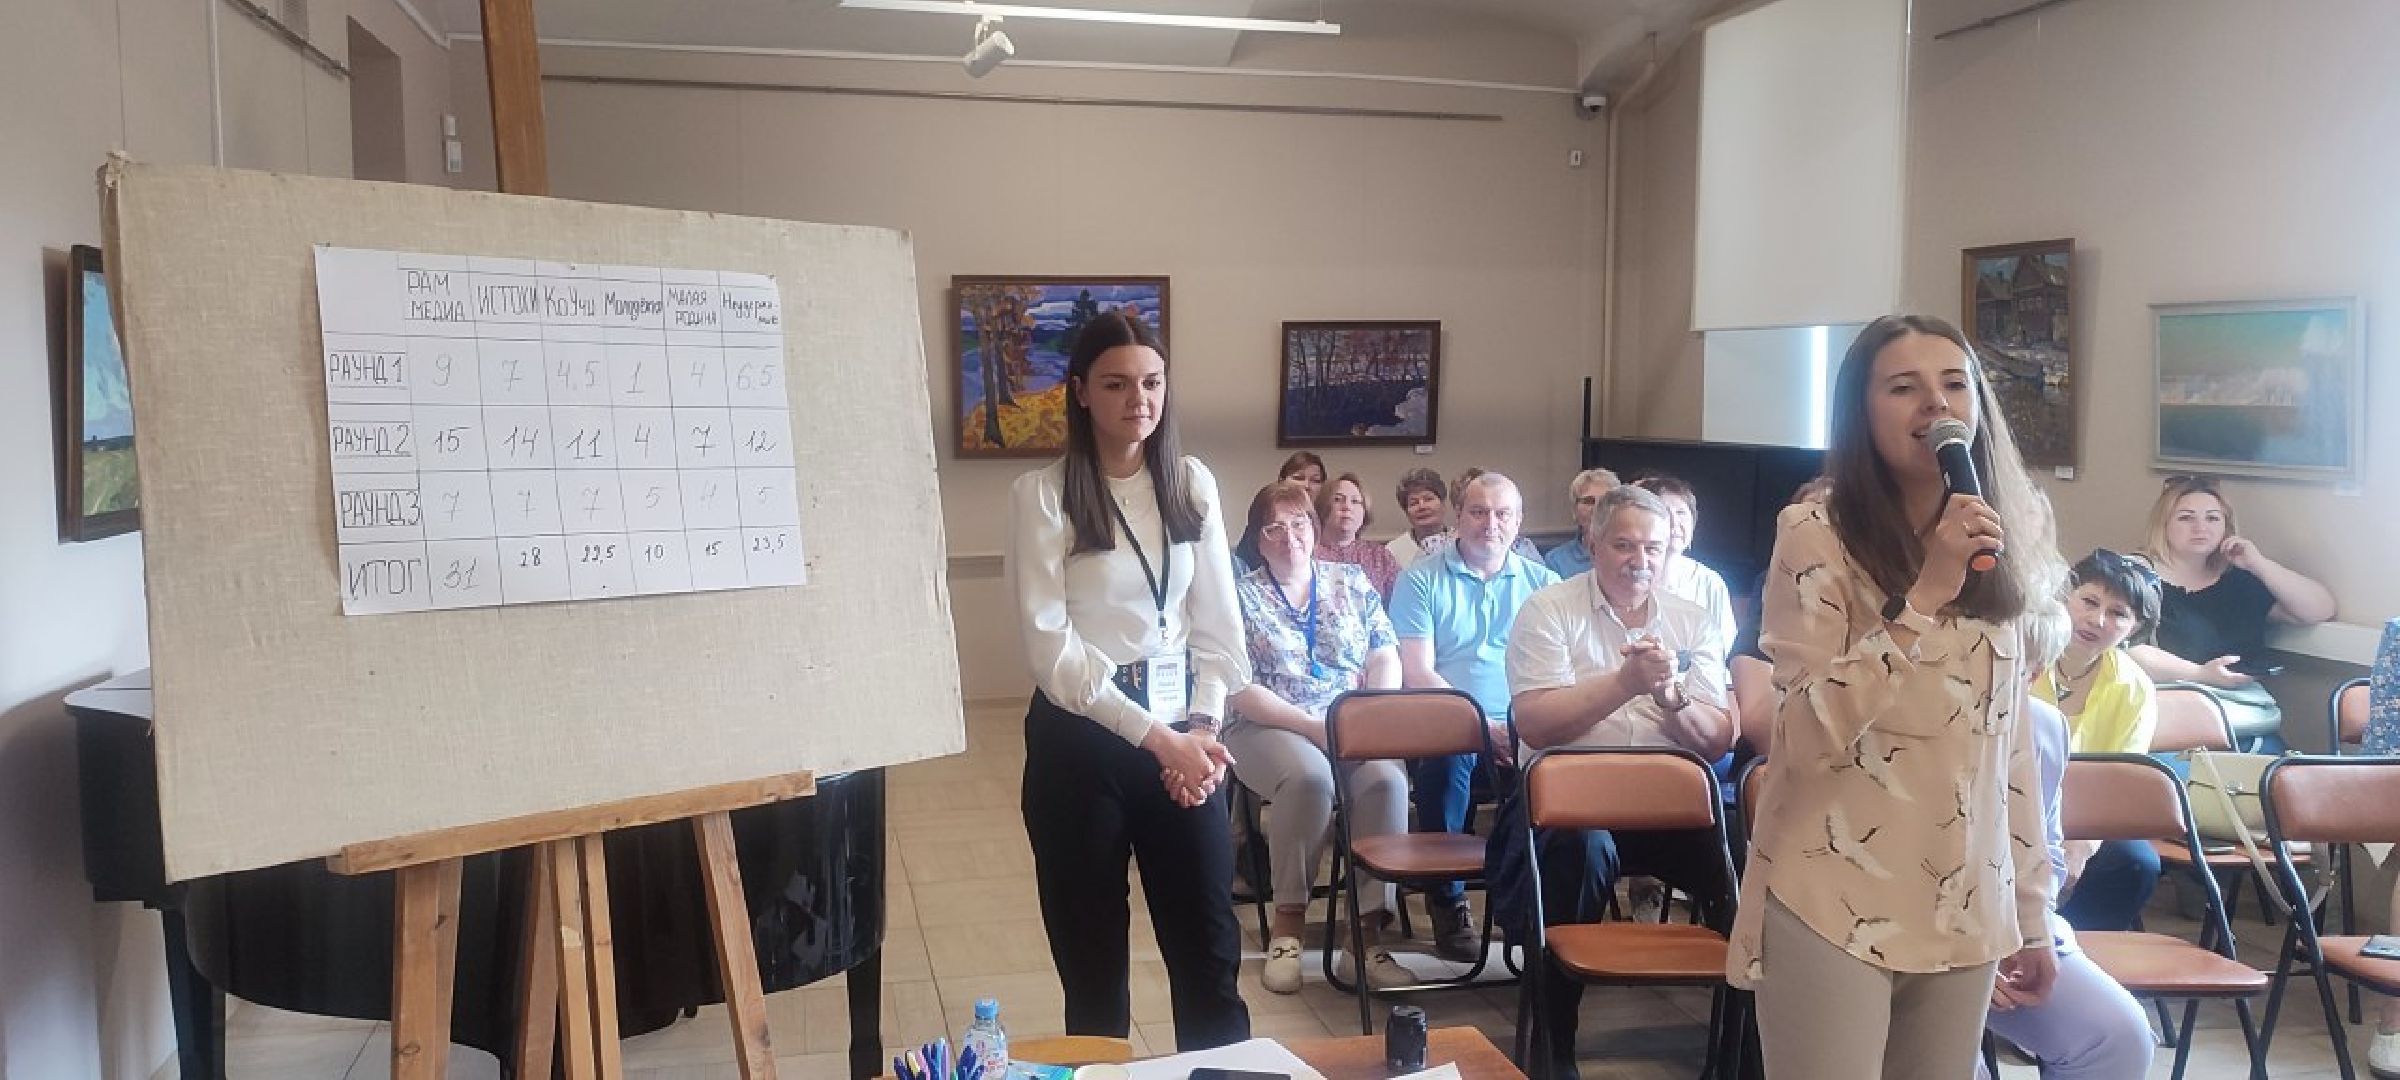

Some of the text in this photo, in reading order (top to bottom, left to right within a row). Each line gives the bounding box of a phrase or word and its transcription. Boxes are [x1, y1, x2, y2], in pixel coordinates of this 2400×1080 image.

[408, 270, 450, 295] РАМ
[411, 300, 465, 322] МЕДИА
[477, 285, 538, 316] ИСТОКИ
[329, 354, 402, 384] РАУНД 1
[433, 354, 452, 386] 9
[502, 359, 523, 391] 7
[626, 361, 645, 393] 1
[690, 361, 706, 388] 4
[332, 424, 410, 454] РАУНД 2
[434, 427, 472, 454] 15
[503, 426, 539, 457] 14
[566, 428, 604, 459] 11
[634, 423, 651, 459] 4
[691, 424, 717, 457] 7
[743, 430, 777, 452] 12
[341, 490, 421, 527] РАУНД 3
[441, 488, 465, 522] 7
[516, 489, 537, 521] 7
[581, 486, 605, 522] 7
[519, 546, 541, 567] 28
[644, 544, 664, 563] 10
[705, 540, 722, 556] 15
[347, 558, 422, 598] ИТОГ
[443, 557, 481, 588] 31
